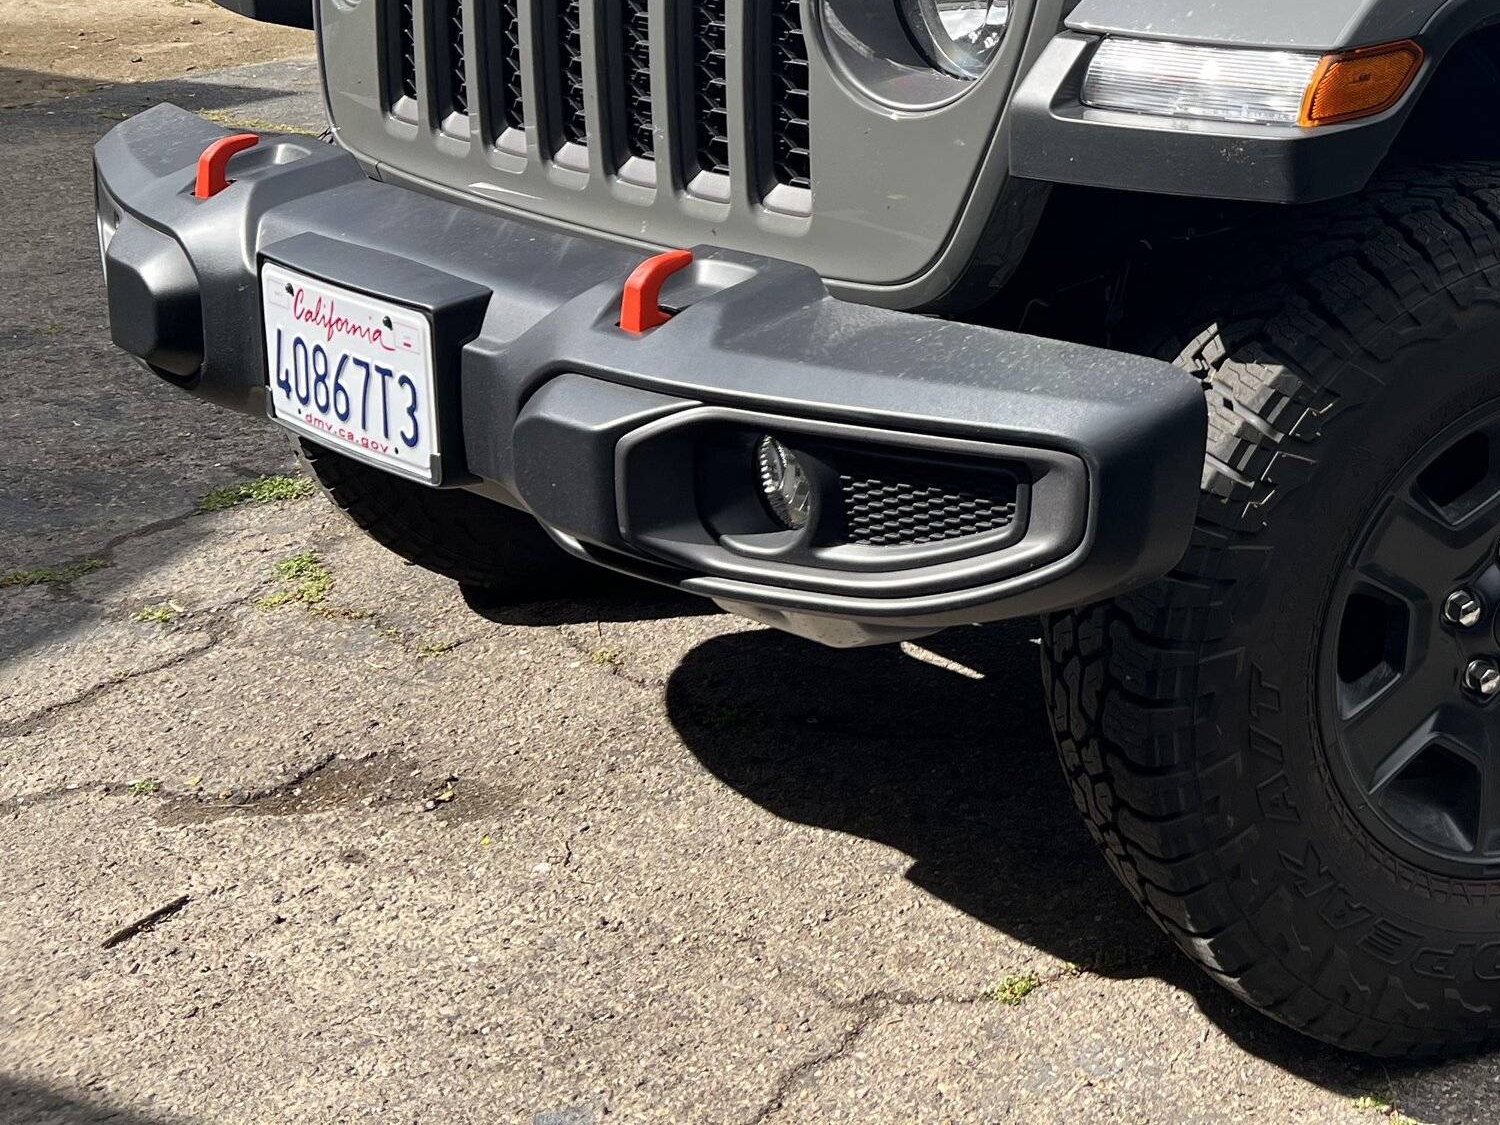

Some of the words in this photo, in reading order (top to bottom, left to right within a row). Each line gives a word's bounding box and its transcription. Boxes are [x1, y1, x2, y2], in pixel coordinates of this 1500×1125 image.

[292, 289, 395, 351] California
[276, 328, 420, 448] 40867T3
[305, 412, 389, 453] dmv.ca.gov
